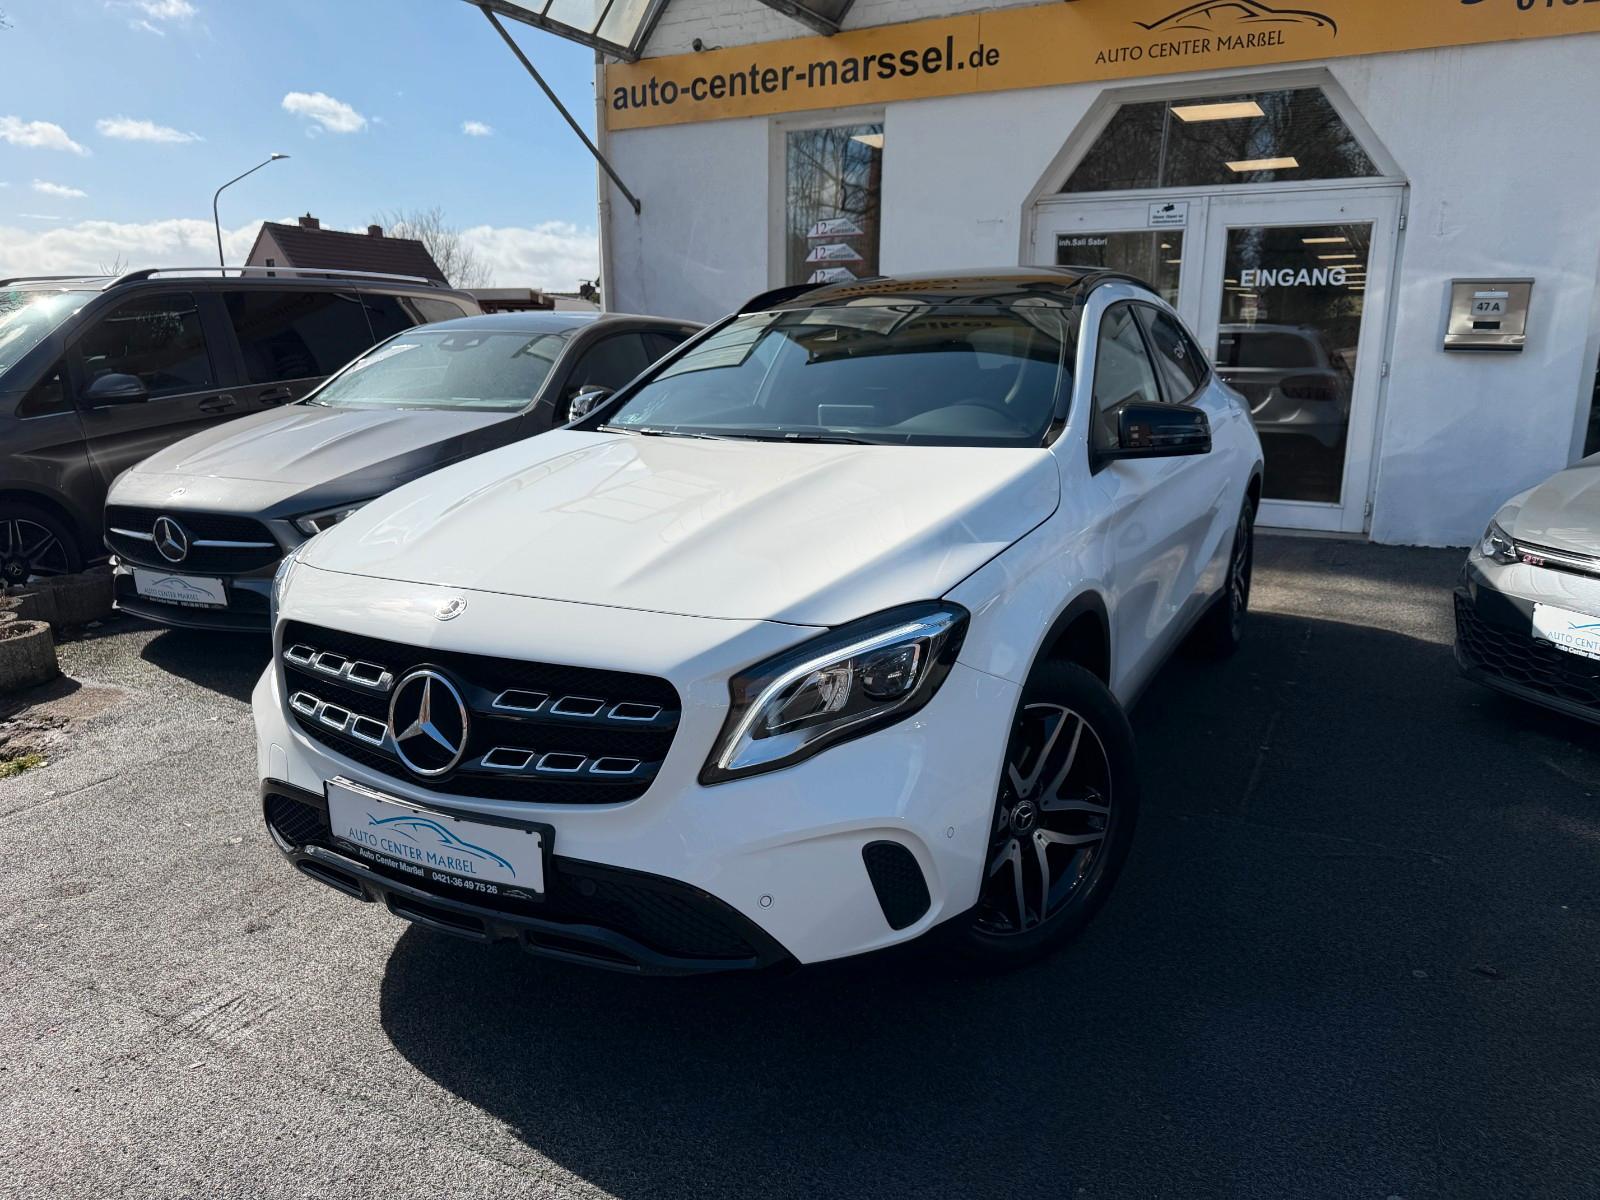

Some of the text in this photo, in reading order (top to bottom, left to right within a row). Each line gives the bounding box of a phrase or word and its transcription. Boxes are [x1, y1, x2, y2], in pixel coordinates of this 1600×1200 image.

[1095, 46, 1142, 64] AUTO
[1148, 38, 1211, 59] CENTER
[613, 36, 1000, 110] auto-center-marssel.de
[815, 222, 827, 235] 12
[814, 247, 827, 260] 12
[1240, 267, 1347, 288] EINGANG
[1476, 302, 1500, 312] 47 A
[1546, 631, 1600, 650] AUTO CENT
[349, 827, 378, 847] AUTO
[380, 838, 423, 861] CENTER
[359, 847, 375, 860] Auto
[375, 854, 399, 869] Center
[432, 871, 463, 888] 0421-36
[464, 880, 475, 890] 49
[475, 883, 486, 893] 75
[486, 884, 498, 895] 26
